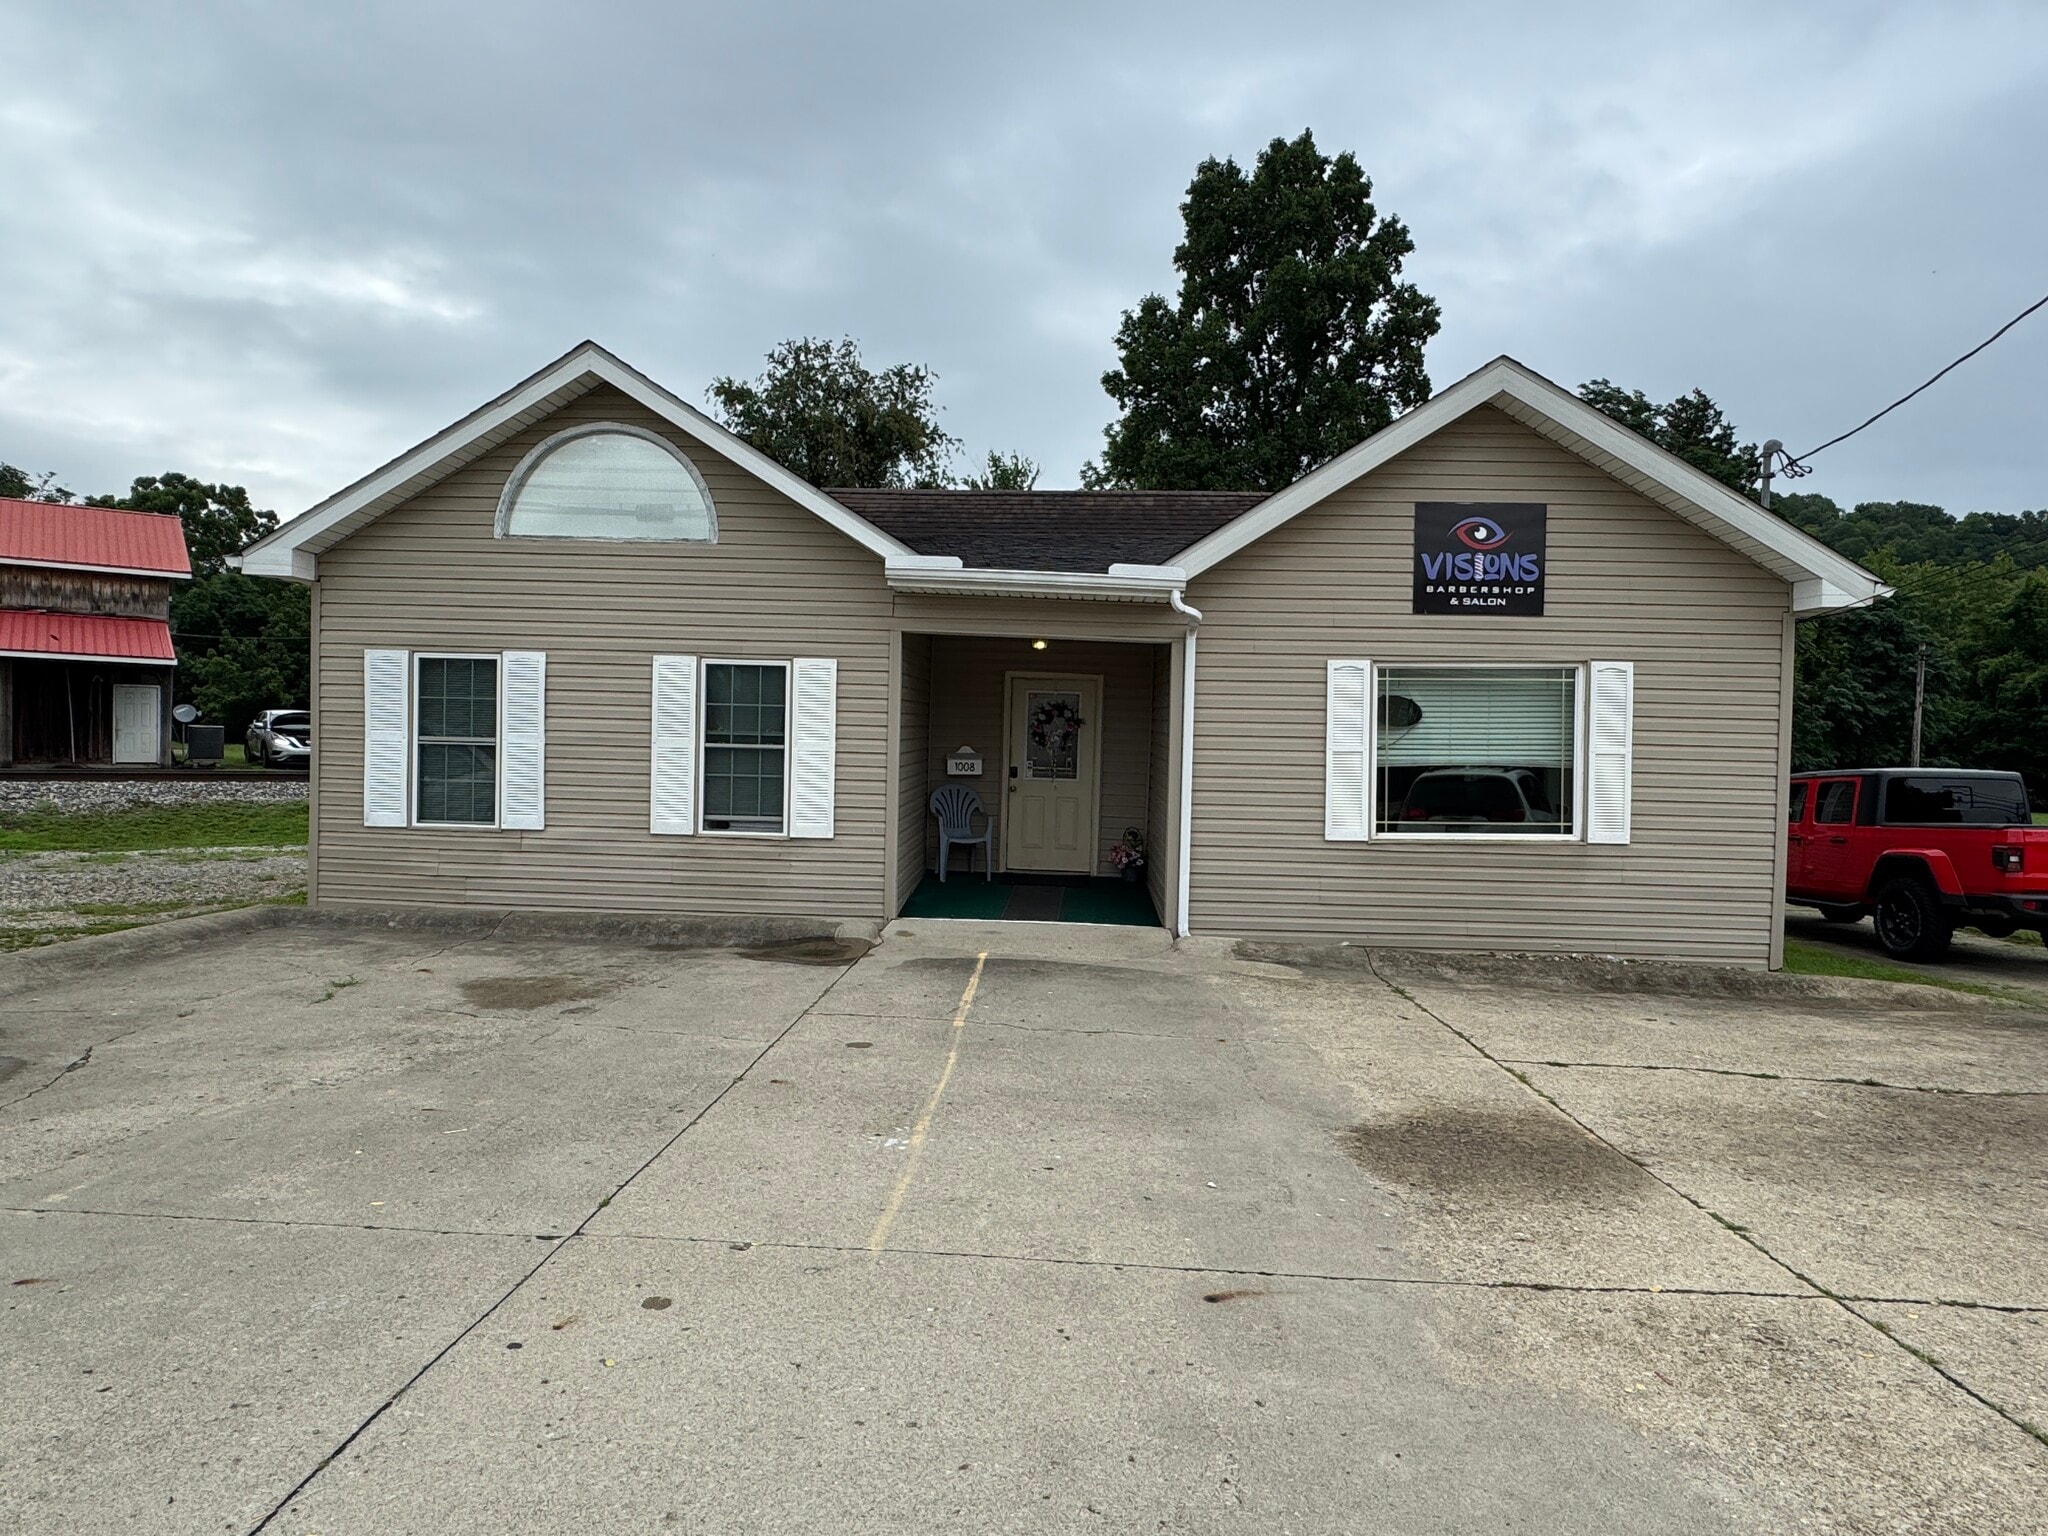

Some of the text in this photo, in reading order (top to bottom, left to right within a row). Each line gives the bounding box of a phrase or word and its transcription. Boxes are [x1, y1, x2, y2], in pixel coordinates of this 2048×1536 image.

[1420, 552, 1540, 582] VISIONS
[1426, 585, 1536, 595] BARBERSHOP
[1449, 597, 1507, 606] & SALON
[954, 761, 976, 772] 1008
